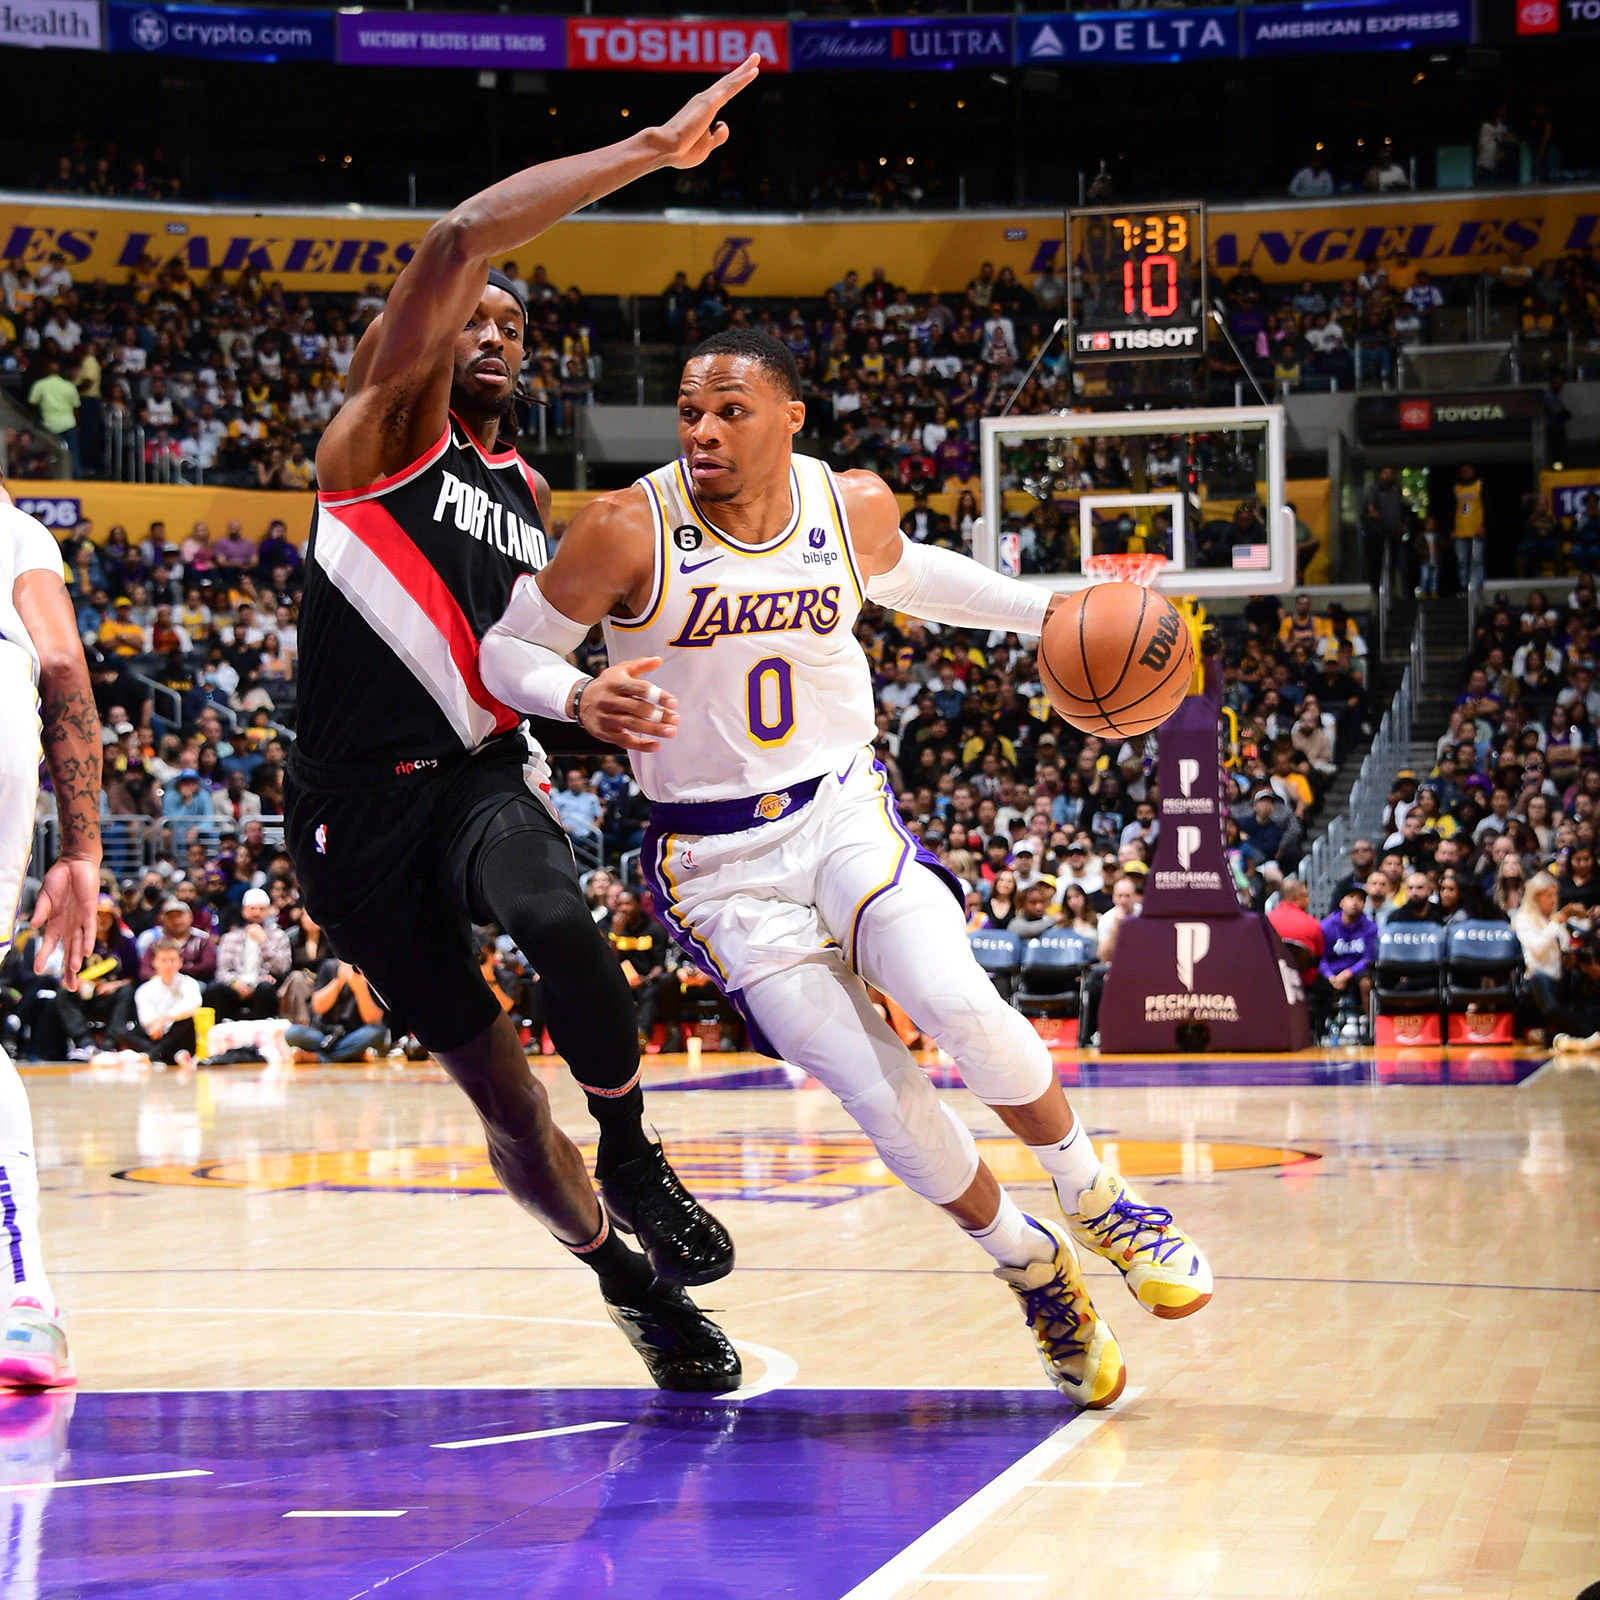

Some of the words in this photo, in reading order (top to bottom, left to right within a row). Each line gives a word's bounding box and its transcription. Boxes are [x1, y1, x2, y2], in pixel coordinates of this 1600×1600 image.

[171, 24, 313, 47] crypto.com
[1079, 19, 1226, 52] DELTA
[1256, 19, 1361, 40] AMERICAN
[1366, 11, 1460, 34] EXPRESS
[358, 30, 418, 49] VICTORY
[420, 32, 468, 50] TASTES
[471, 34, 501, 51] LIKE
[504, 34, 546, 52] TACOS
[577, 28, 778, 64] TOSHIBA
[800, 34, 888, 58] Michelob
[909, 29, 1004, 56] ULTRA
[1112, 215, 1187, 254] 7:33
[1123, 254, 1178, 317] 10
[1110, 327, 1199, 349] TISSOT
[1435, 404, 1504, 422] TOYOTA
[432, 469, 549, 572] PORTLAND
[679, 528, 697, 549] 6
[802, 550, 838, 566] bibigo
[666, 583, 843, 650] LAKERS
[744, 653, 797, 750] 0
[1162, 798, 1214, 808] PECHANGA
[1155, 871, 1220, 882] PECHANGA
[973, 937, 1014, 952] DELTA
[1041, 937, 1084, 949] DELTA
[1393, 932, 1437, 945] DELTA
[1468, 929, 1512, 942] DELTA
[1145, 994, 1237, 1010] PECHANGA
[1145, 1009, 1190, 1021] RESORT
[1193, 1008, 1239, 1021] CASINO
